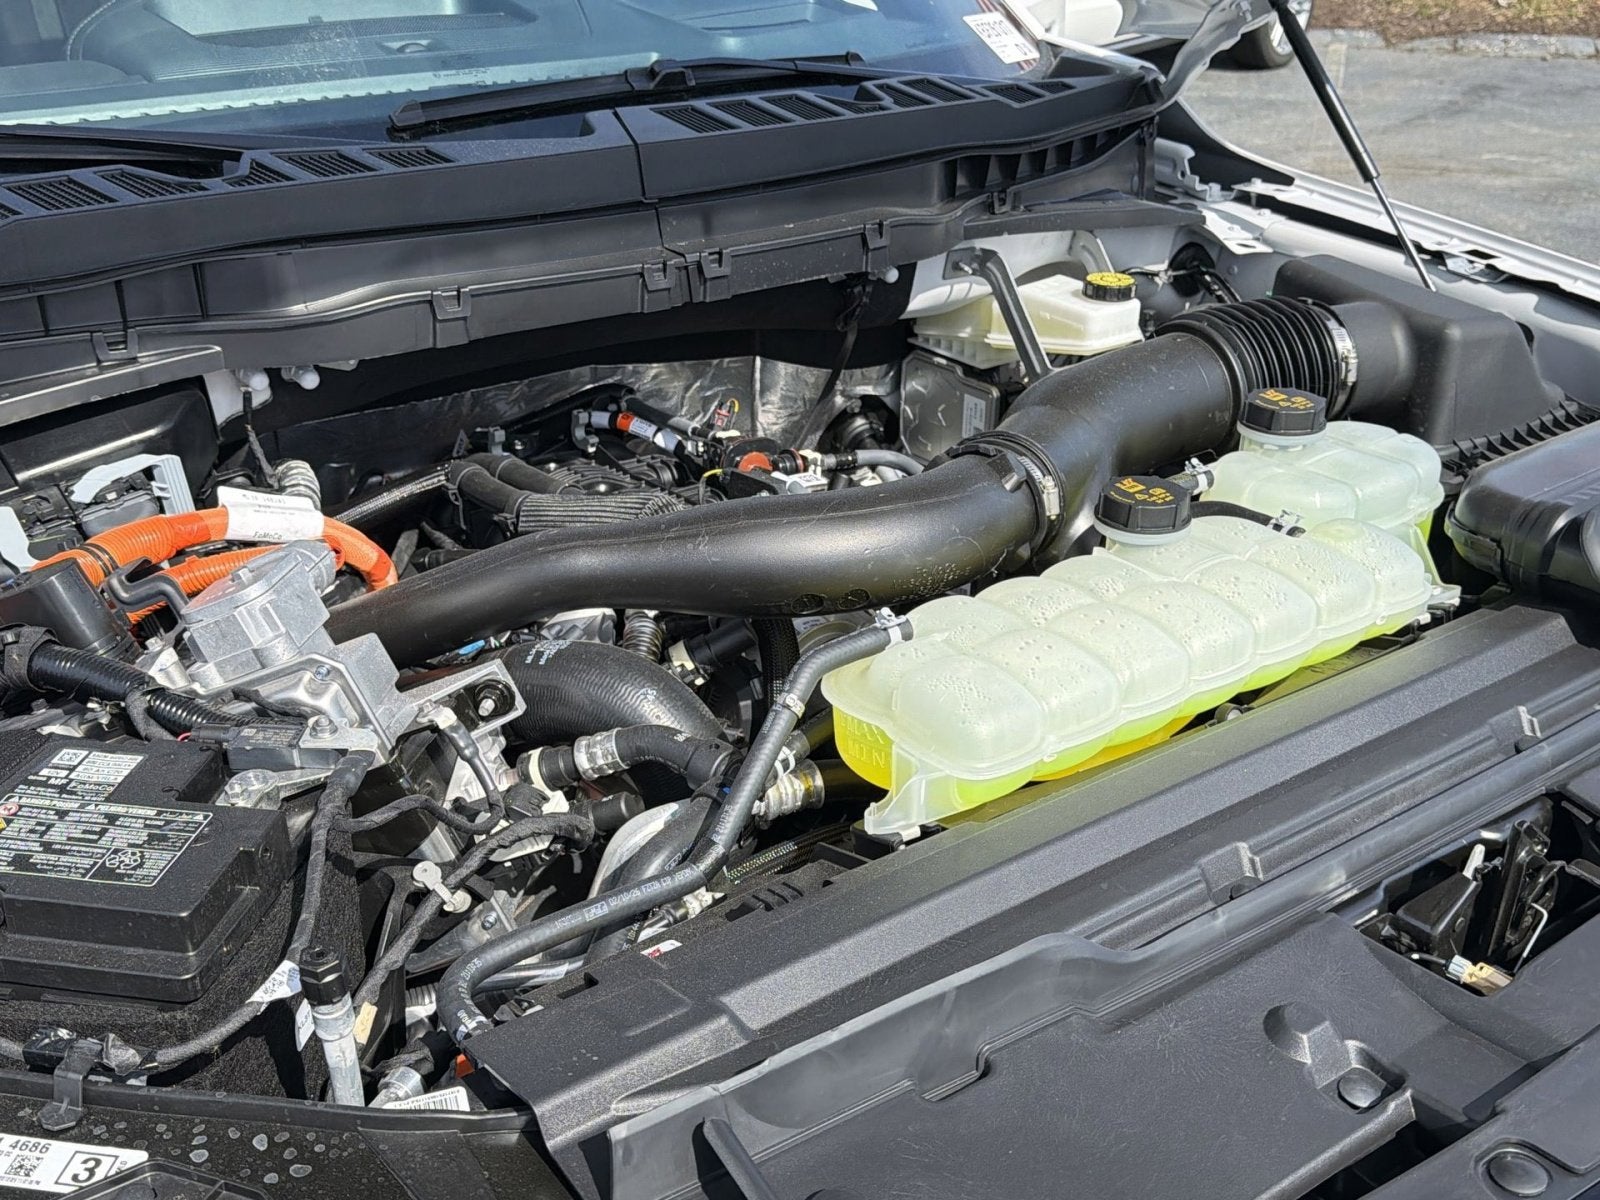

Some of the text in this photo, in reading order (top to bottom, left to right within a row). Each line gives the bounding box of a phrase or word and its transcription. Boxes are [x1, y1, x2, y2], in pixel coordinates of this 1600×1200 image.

[252, 531, 283, 540] FoMoCo
[47, 778, 69, 786] MF
[70, 782, 114, 792] FoMoCo
[9, 1139, 52, 1154] 4686
[71, 1157, 102, 1184] 3
